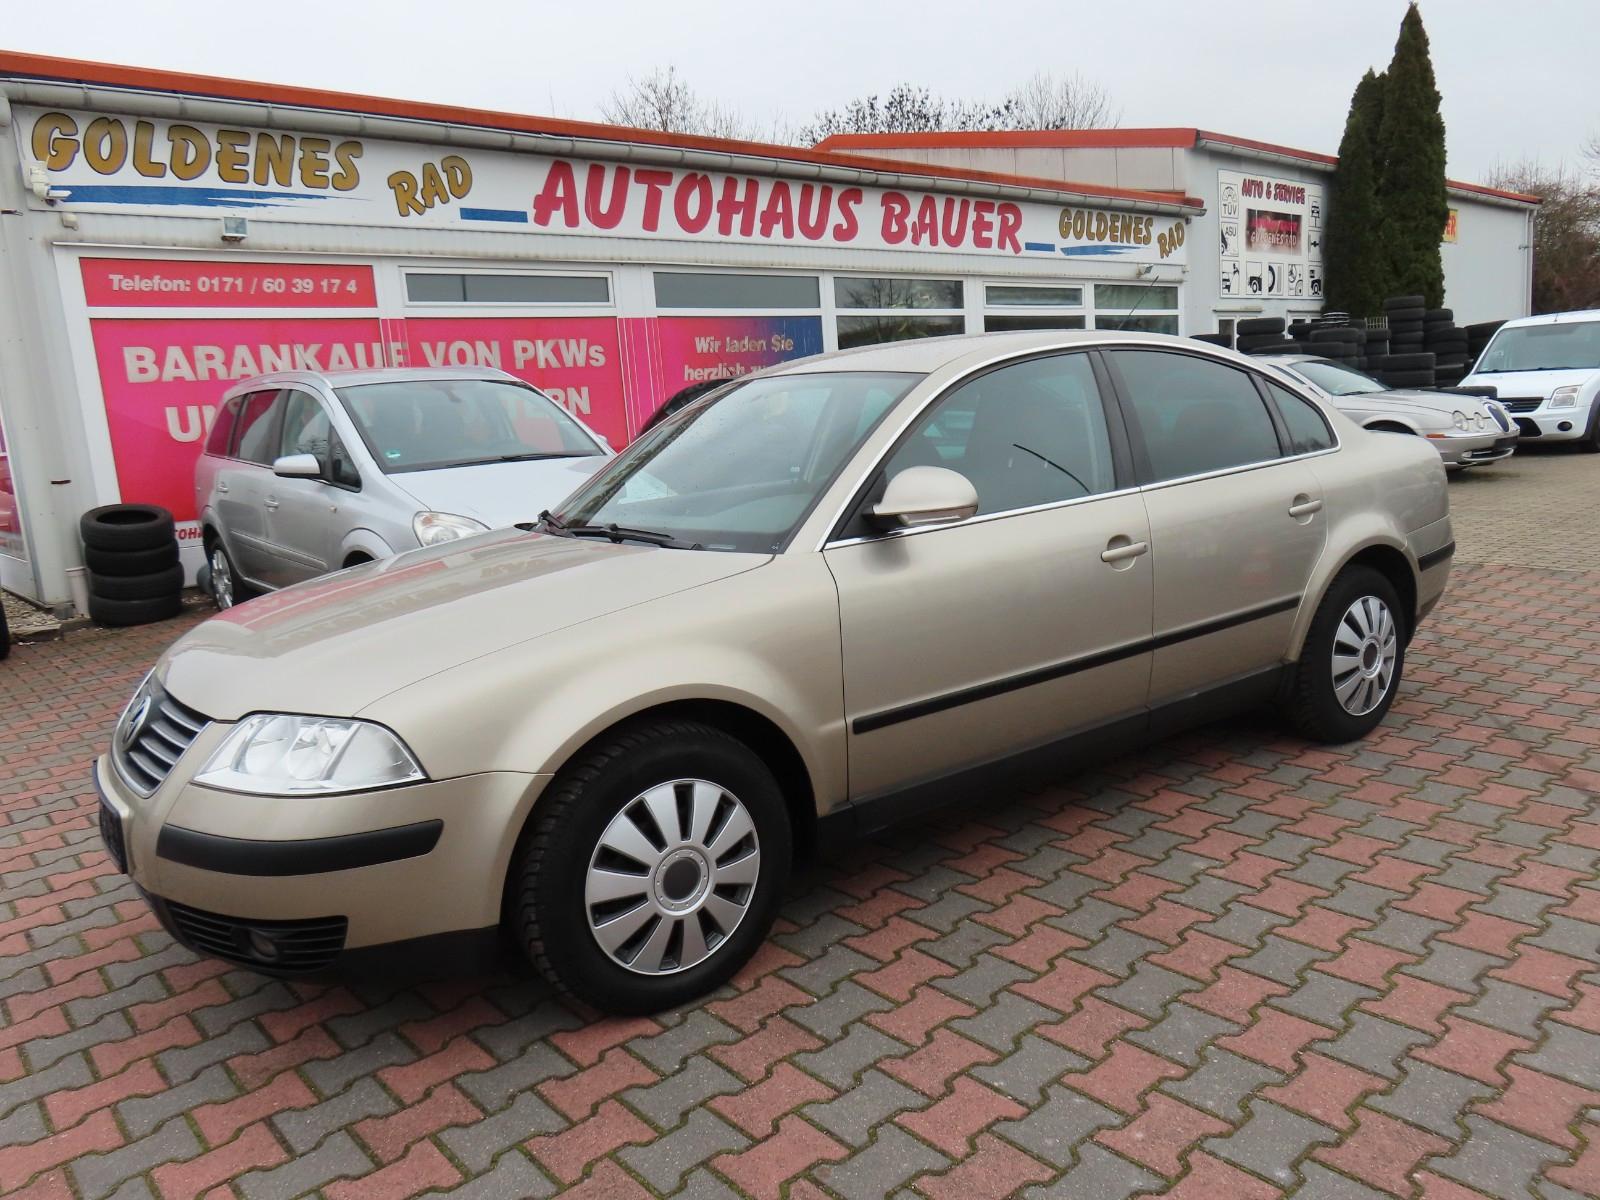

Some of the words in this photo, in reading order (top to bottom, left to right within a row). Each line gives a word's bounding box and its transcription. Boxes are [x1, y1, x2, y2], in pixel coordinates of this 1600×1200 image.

[32, 112, 364, 192] GOLDENES
[387, 155, 473, 217] RAD
[1242, 178, 1263, 199] AUTO
[1266, 182, 1272, 199] &
[1274, 183, 1305, 204] SERVICE
[532, 160, 864, 243] AUTOHAUS
[881, 191, 1023, 254] BAUER
[1223, 202, 1237, 215] TÜV
[1059, 208, 1154, 245] GOLDENES
[1157, 222, 1185, 259] RAD
[1225, 226, 1237, 237] ASU
[109, 274, 191, 292] Telefon:
[197, 276, 244, 293] 0171
[250, 278, 257, 294] /
[262, 278, 286, 293] 60
[292, 279, 314, 294] 39
[320, 279, 341, 293] 17
[346, 280, 357, 293] 4
[695, 335, 720, 353] Wir
[726, 336, 766, 352] laden
[771, 334, 794, 352] Sie
[122, 341, 408, 384] BARANKAUF
[421, 341, 501, 369] VON
[513, 338, 606, 370] PKWs
[684, 362, 745, 381] herzlich
